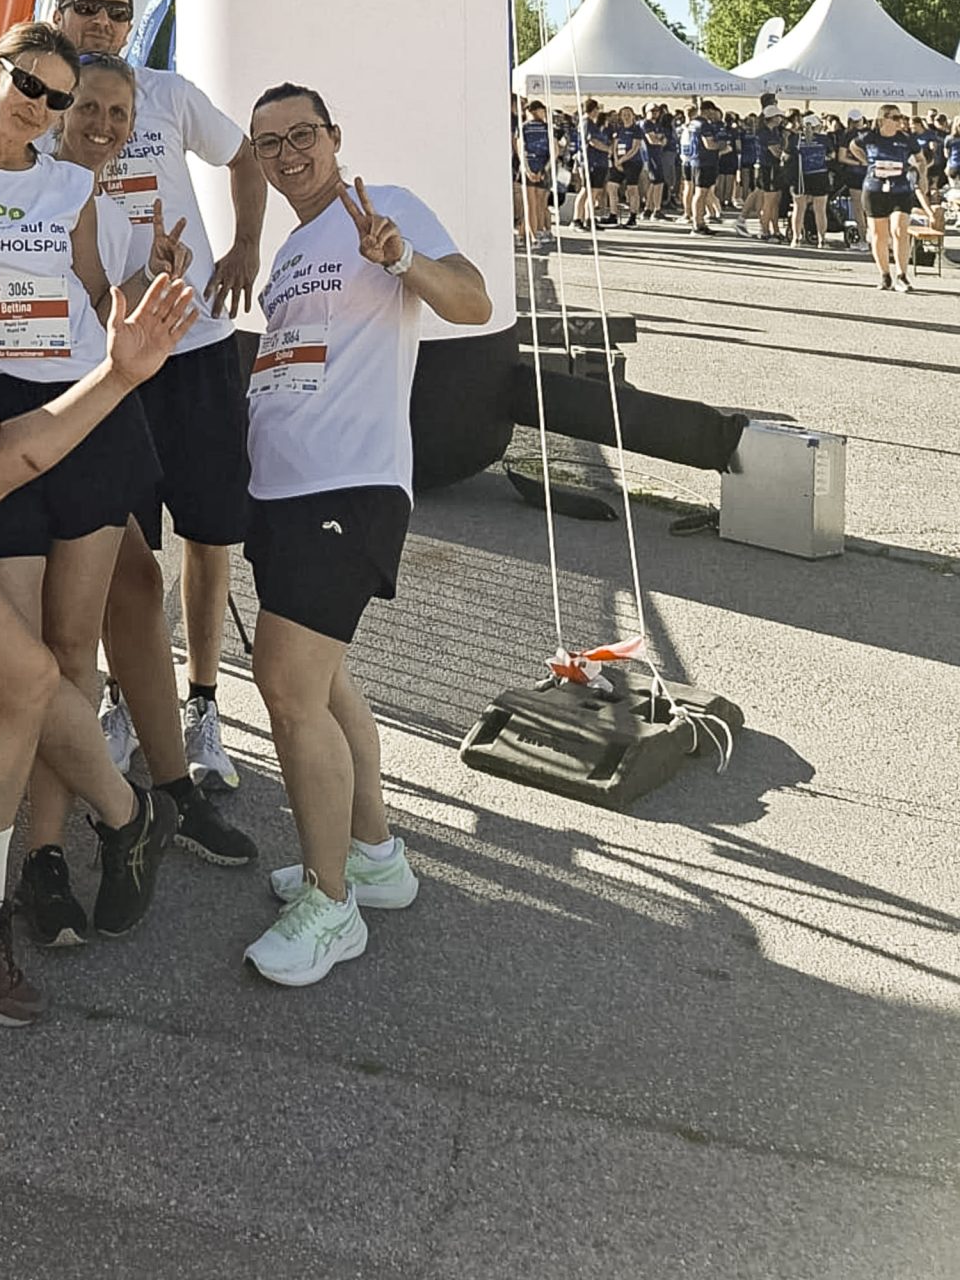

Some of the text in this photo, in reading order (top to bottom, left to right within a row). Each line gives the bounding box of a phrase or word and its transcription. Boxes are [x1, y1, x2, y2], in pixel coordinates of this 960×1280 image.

[615, 80, 635, 91] Wir
[637, 80, 658, 91] sind
[698, 81, 712, 92] im
[860, 87, 880, 97] Wir
[881, 87, 905, 97] sind
[117, 145, 165, 159] OLSPUR
[21, 221, 43, 233] auf
[293, 262, 343, 279] auf der
[8, 281, 35, 297] 3065
[0, 303, 32, 314] Bettina
